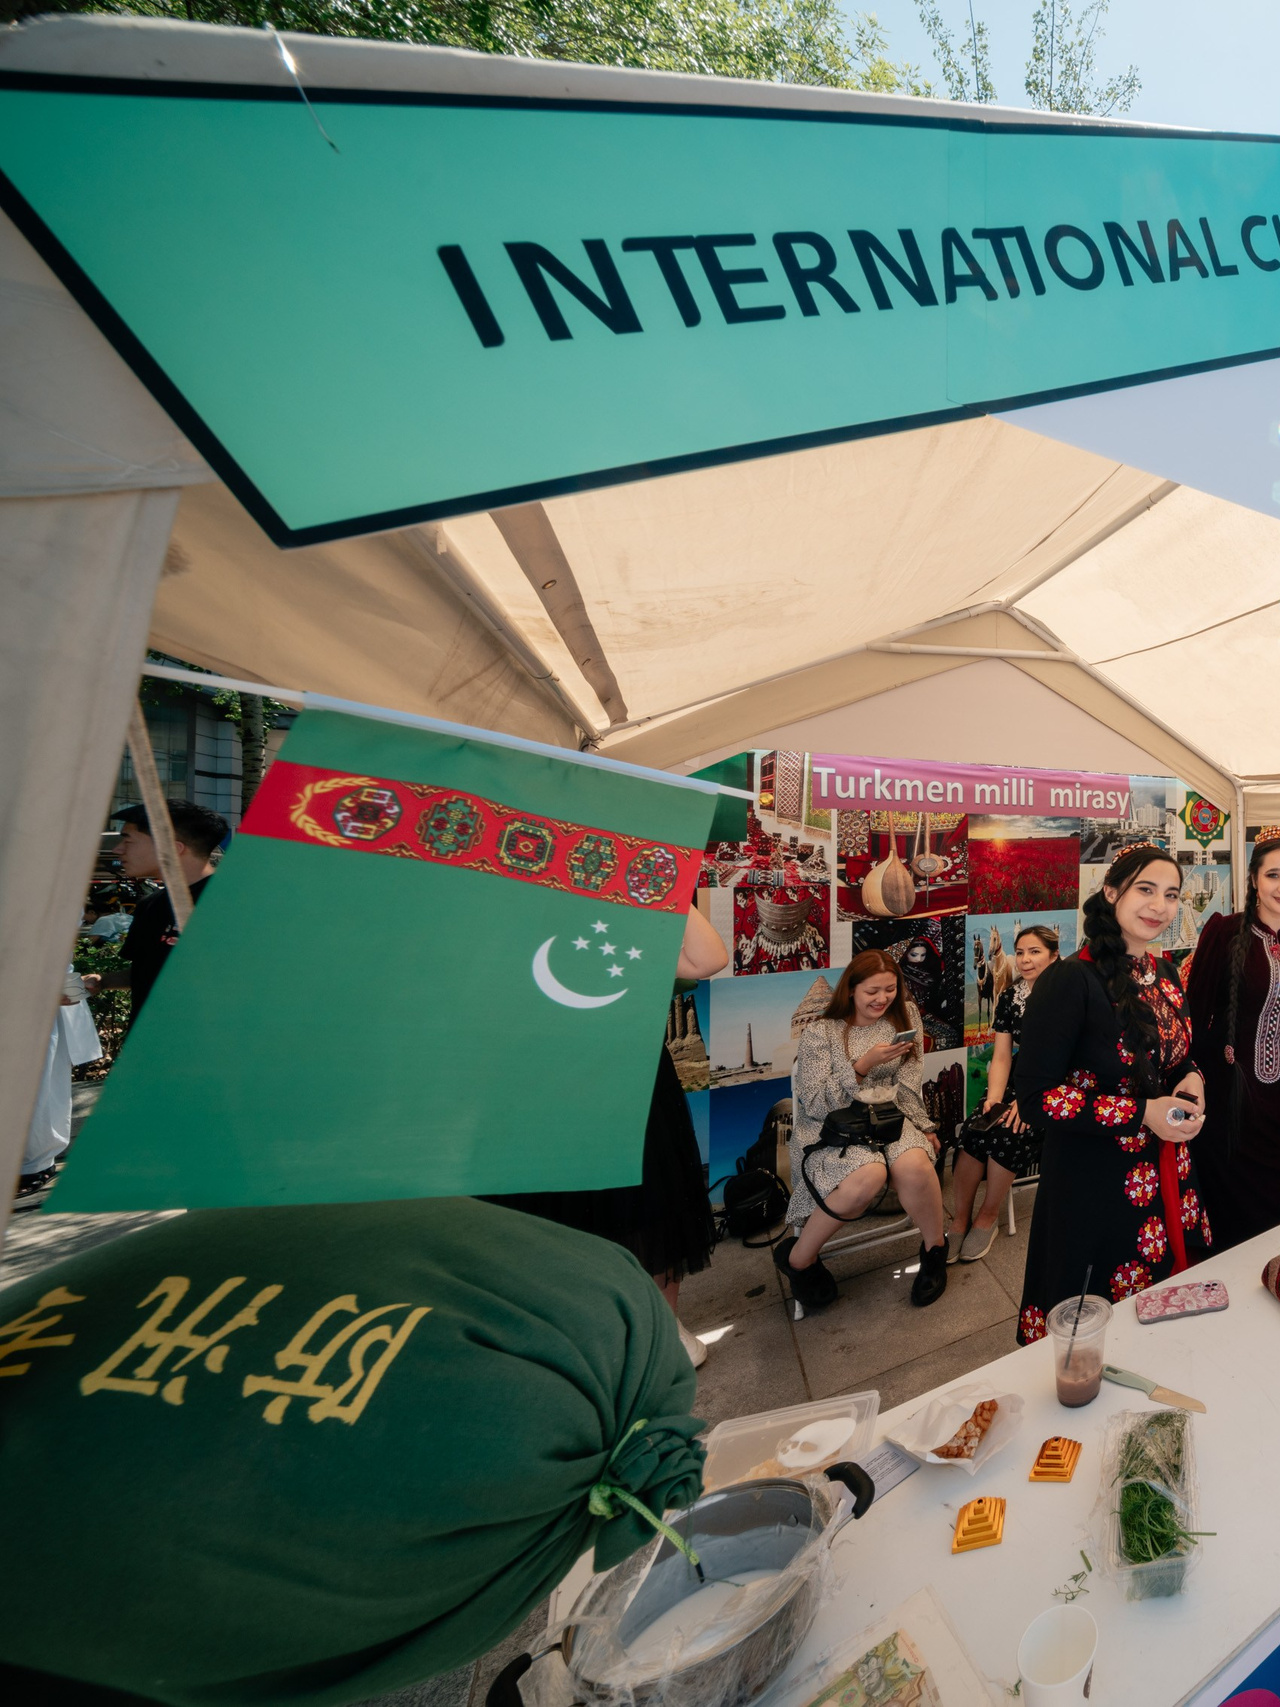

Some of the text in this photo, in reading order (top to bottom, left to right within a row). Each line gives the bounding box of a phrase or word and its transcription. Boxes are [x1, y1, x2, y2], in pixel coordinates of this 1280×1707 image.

[436, 215, 1239, 348] INTERNATIONAL
[812, 767, 1130, 816] Turkmen milli mirasy
